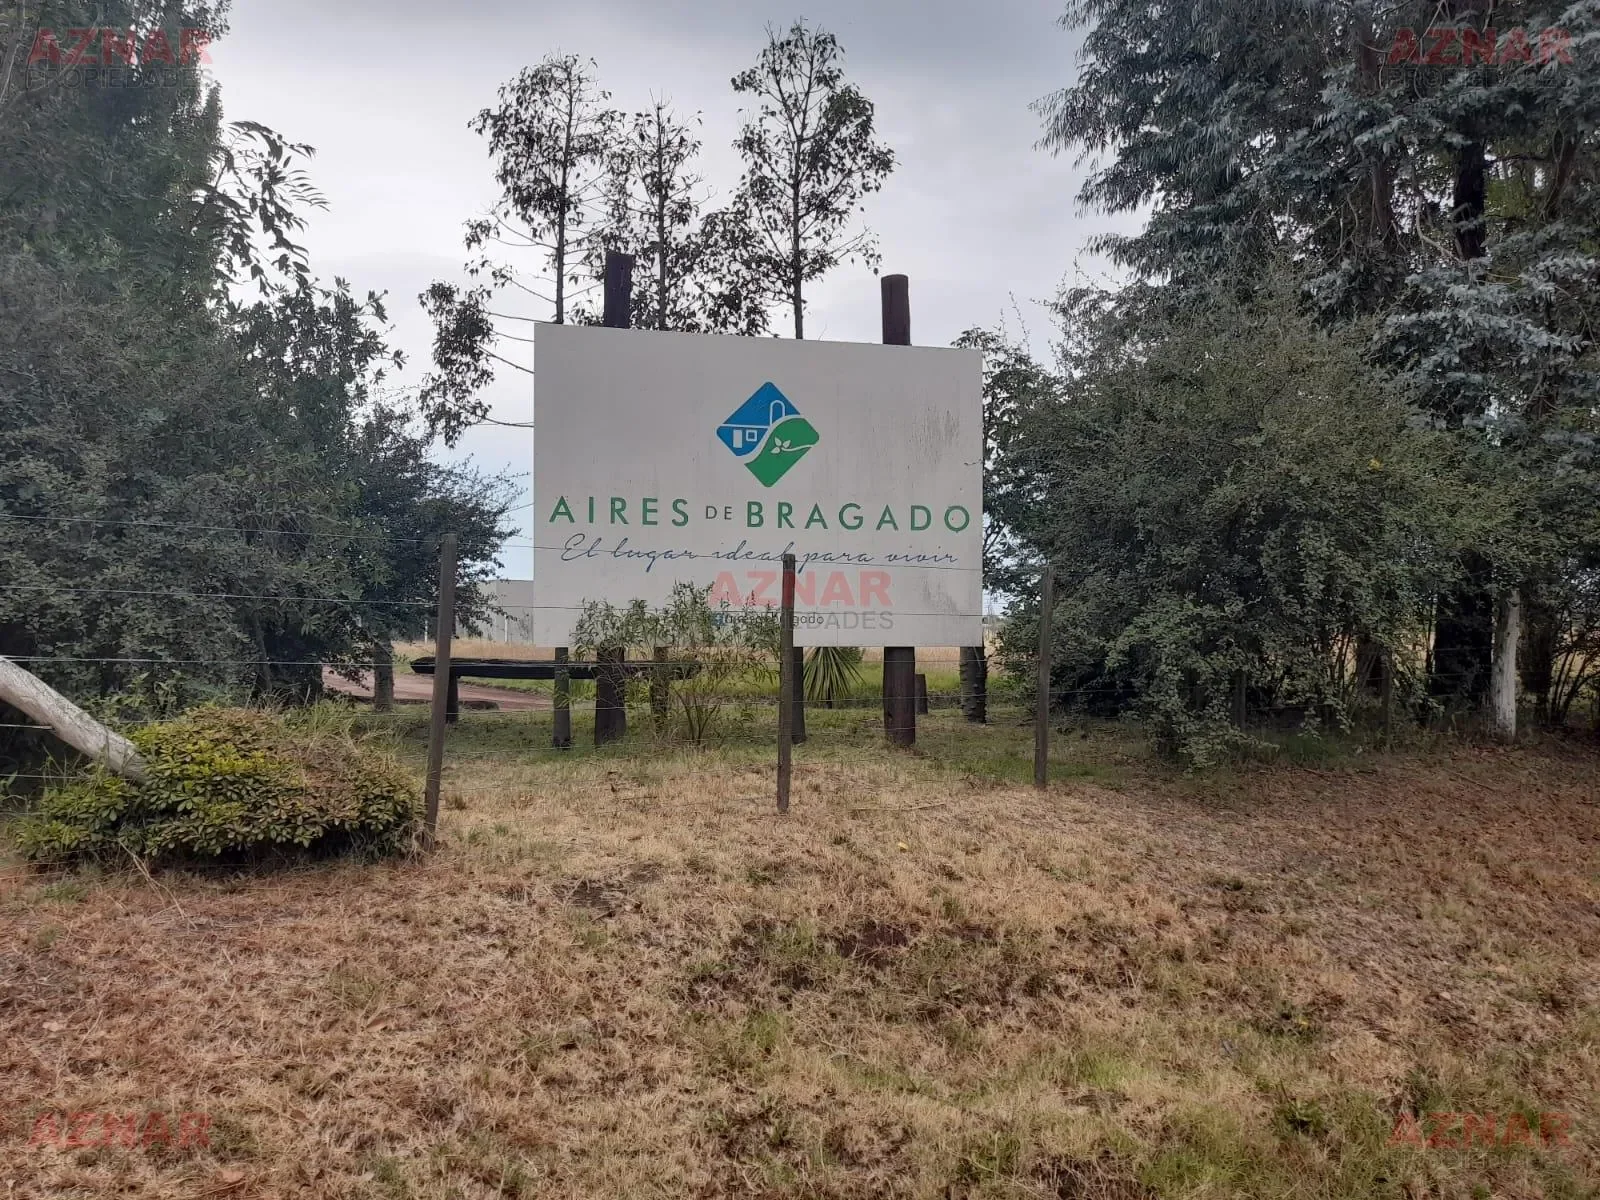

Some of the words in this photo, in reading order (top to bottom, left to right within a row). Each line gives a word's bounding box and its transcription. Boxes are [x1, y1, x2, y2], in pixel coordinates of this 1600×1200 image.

[549, 496, 689, 527] AIRES
[705, 506, 732, 520] DE
[747, 501, 970, 533] BRAGADO
[561, 533, 602, 561] El
[611, 538, 698, 572] lugar
[712, 540, 795, 562] ideal
[798, 550, 874, 574] para
[886, 546, 958, 563] vivir
